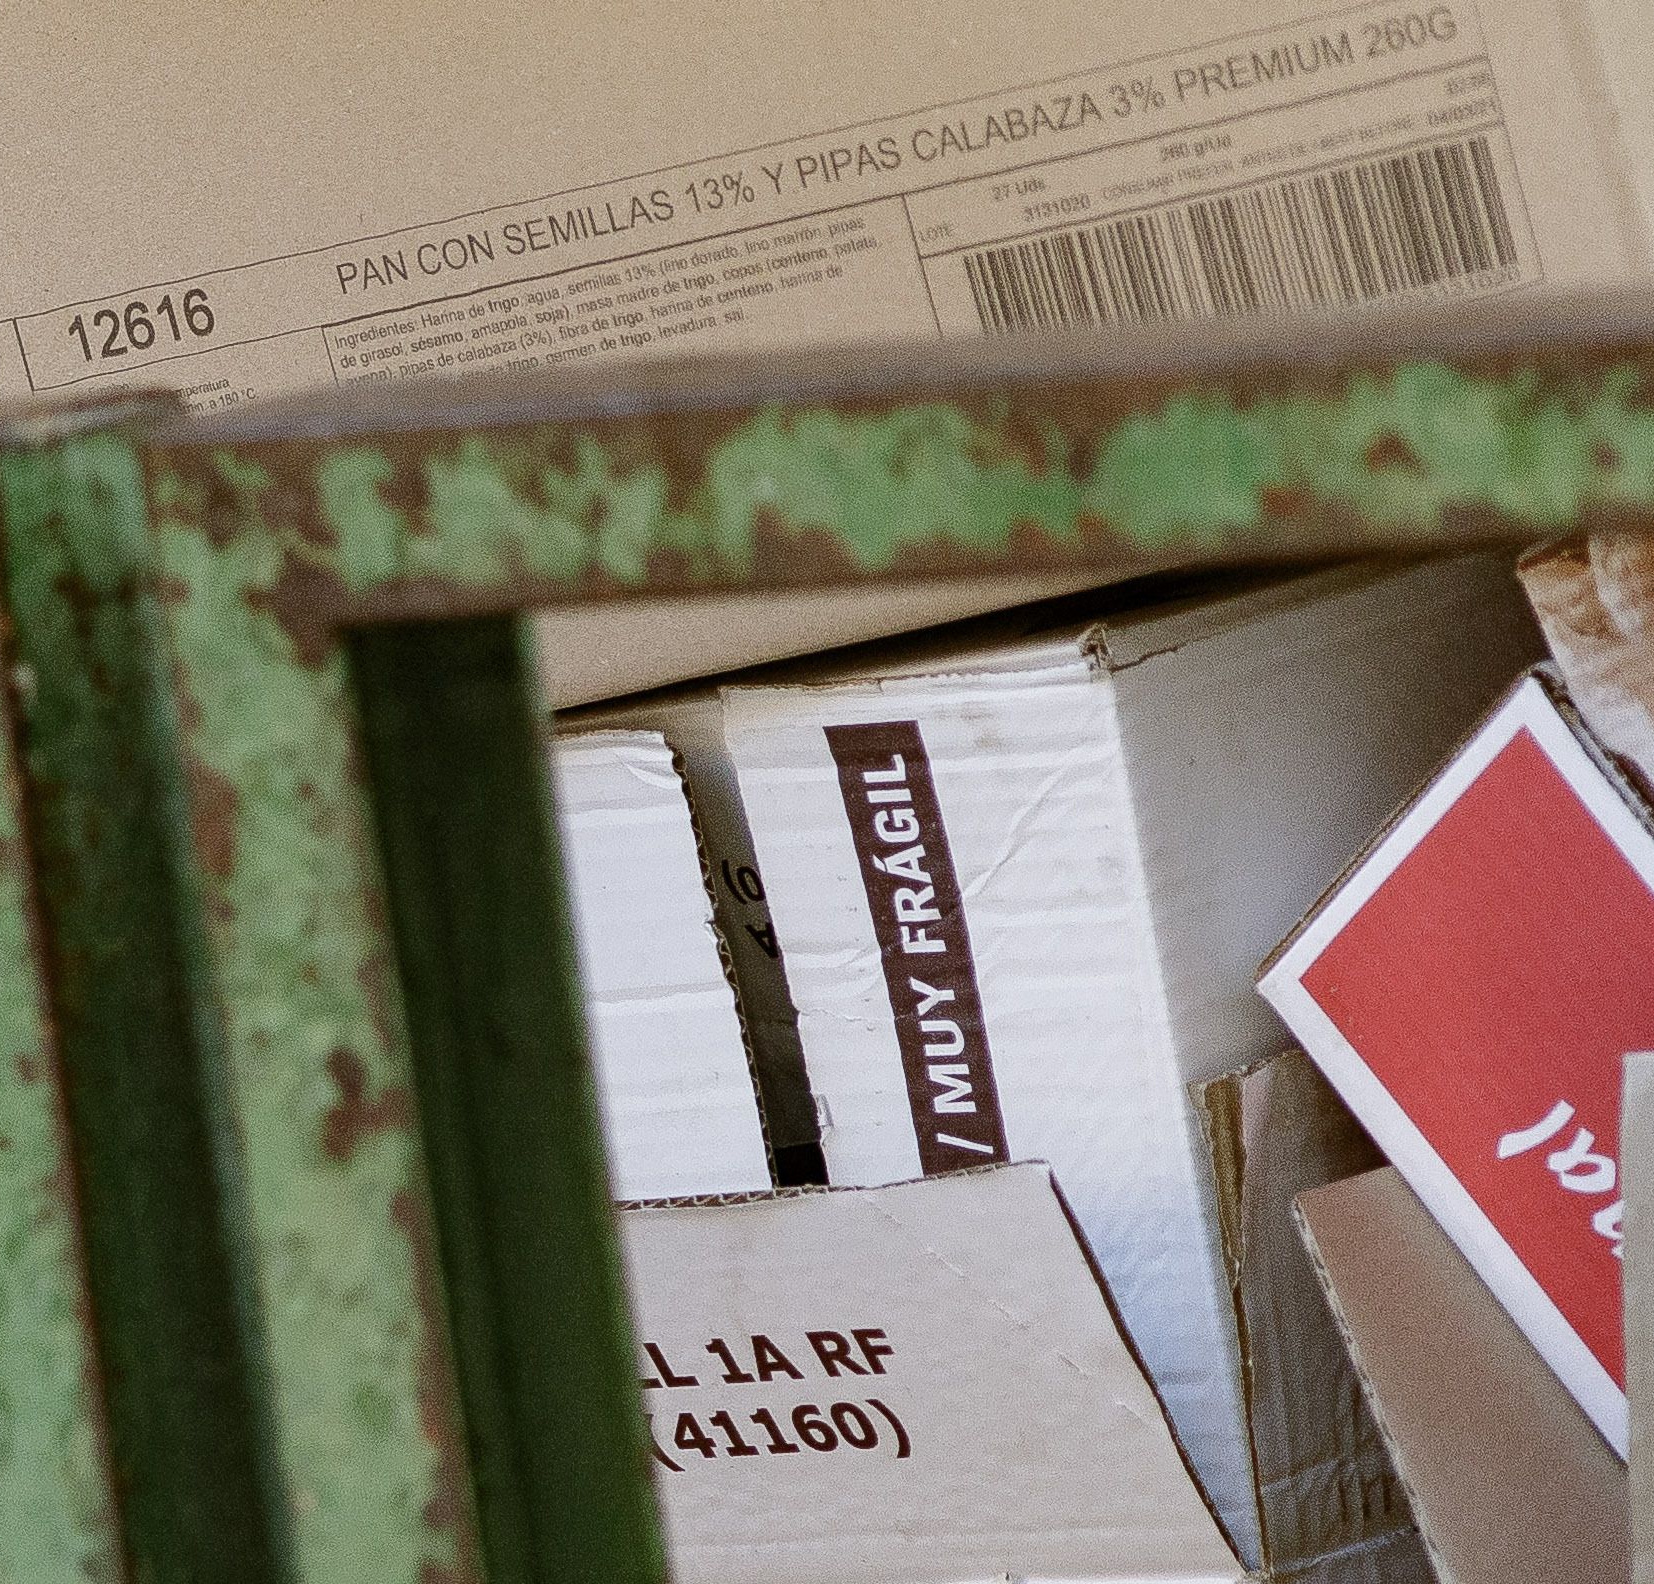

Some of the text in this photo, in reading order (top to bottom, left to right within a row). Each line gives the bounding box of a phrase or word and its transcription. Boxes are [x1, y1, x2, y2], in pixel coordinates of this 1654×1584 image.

[68, 5, 1458, 363] 12616 PAN CON SEMILLAS 13% Y PIPAS CALABAZA 3% PREMIUM 260G
[340, 354, 358, 370] de
[617, 285, 660, 305] madre
[663, 280, 681, 294] de
[722, 265, 764, 285] copos
[400, 357, 435, 381] pipas
[437, 352, 455, 367] de
[457, 338, 517, 363] calabaza
[559, 321, 589, 341] fibra
[592, 316, 609, 331] de
[650, 302, 694, 321] harina
[697, 294, 715, 309] de
[826, 263, 844, 279] de
[421, 310, 466, 328] Harina
[469, 303, 486, 317] de
[568, 271, 620, 297] semillas
[600, 337, 617, 352] de
[862, 753, 947, 954] FRÁGIL
[909, 976, 977, 1114] MUY
[705, 1334, 805, 1384] 1A
[805, 1328, 895, 1377] RF
[648, 1398, 912, 1473] (41160)
